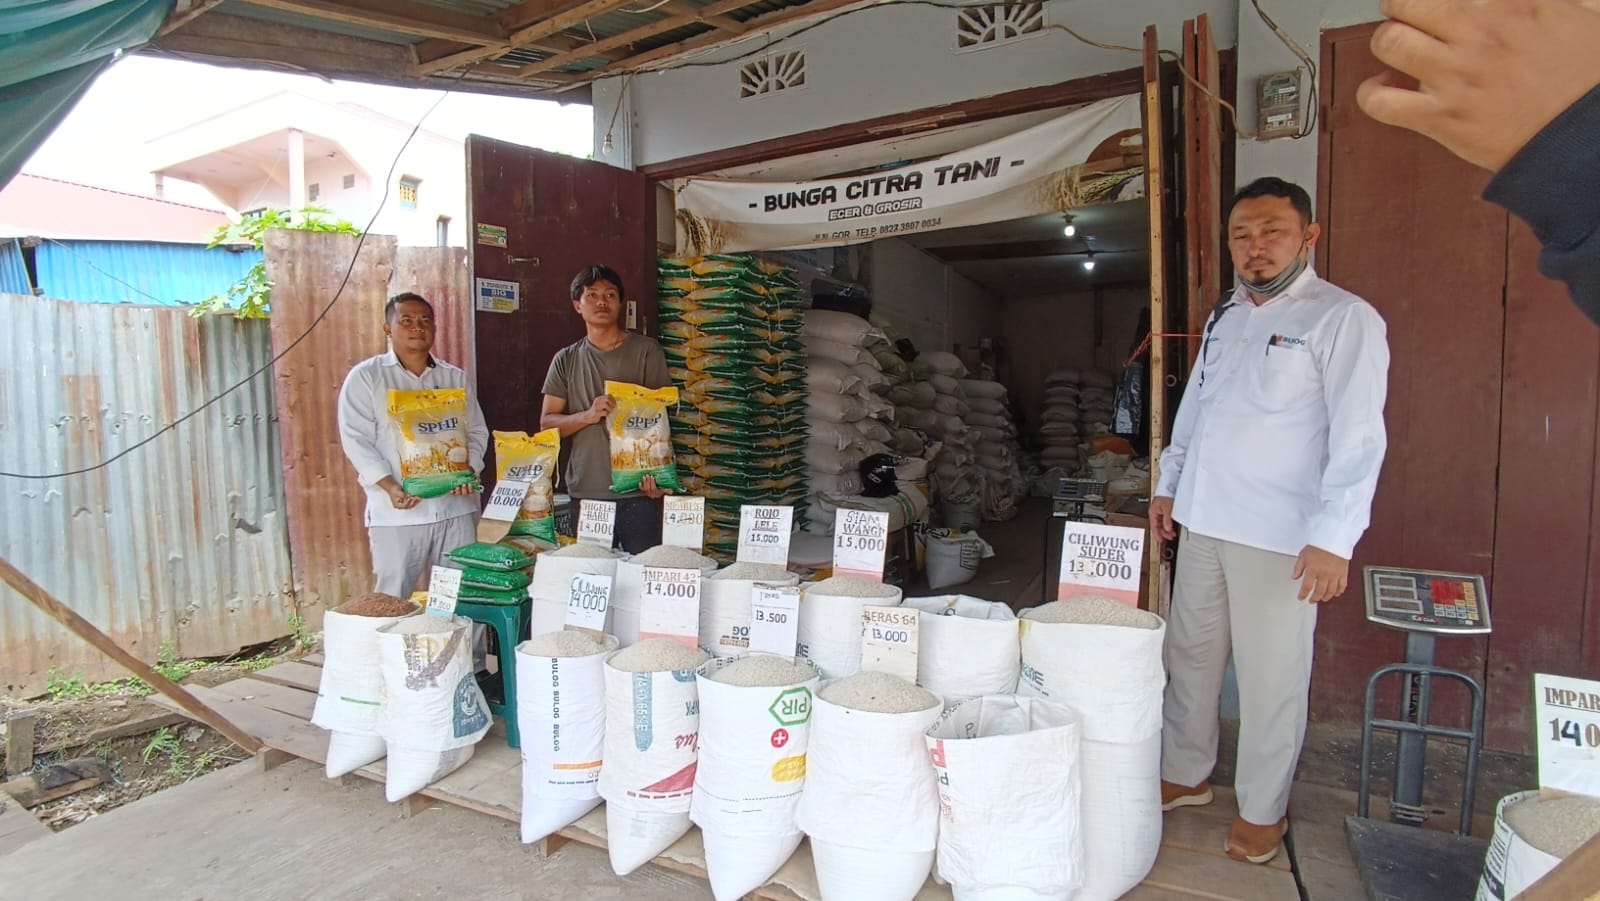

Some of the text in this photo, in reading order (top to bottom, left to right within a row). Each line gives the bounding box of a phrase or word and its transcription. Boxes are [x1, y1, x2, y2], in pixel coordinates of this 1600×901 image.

[764, 156, 1001, 212] BUNGA CITRA TANI
[828, 206, 862, 221] ECER
[875, 197, 923, 215] GROSIR
[418, 417, 459, 432] SPHP
[754, 508, 780, 519] ROJO
[751, 533, 779, 544] 15.000
[837, 535, 885, 551] 15.000
[1068, 533, 1140, 551] CILIWUNG
[1079, 546, 1126, 561] SUPER
[646, 582, 696, 598] 14.000
[755, 609, 787, 624] 13.500
[863, 610, 917, 626] BERAS 64
[872, 627, 908, 643] 13.000
